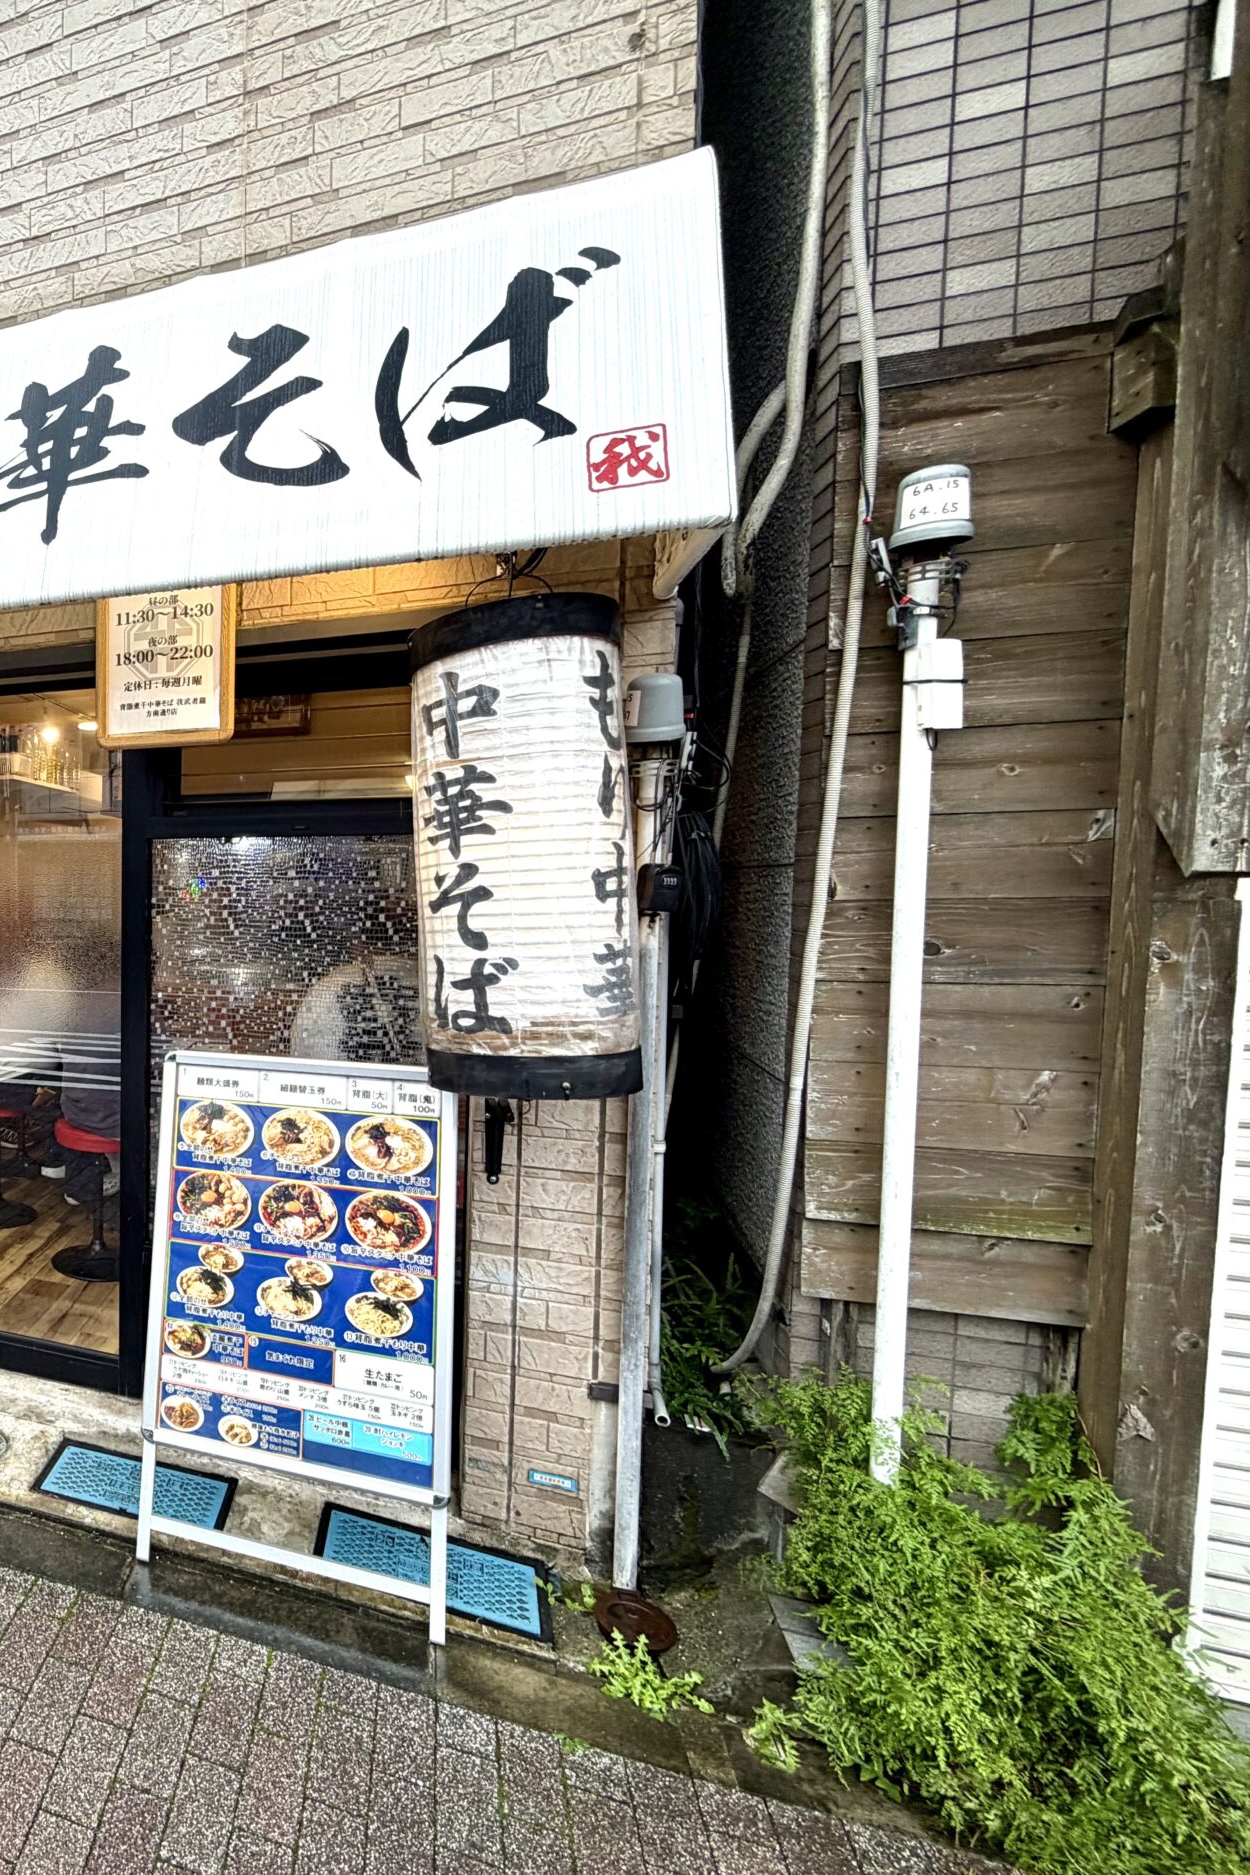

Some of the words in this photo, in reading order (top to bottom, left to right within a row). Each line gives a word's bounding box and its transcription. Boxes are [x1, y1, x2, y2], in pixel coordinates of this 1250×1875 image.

[116, 603, 214, 626] 11:30～14:30
[148, 635, 178, 647] 夜の部
[115, 644, 214, 667] 18:00～22:00
[420, 671, 519, 1035] 中華そば
[339, 1353, 346, 1363] 16
